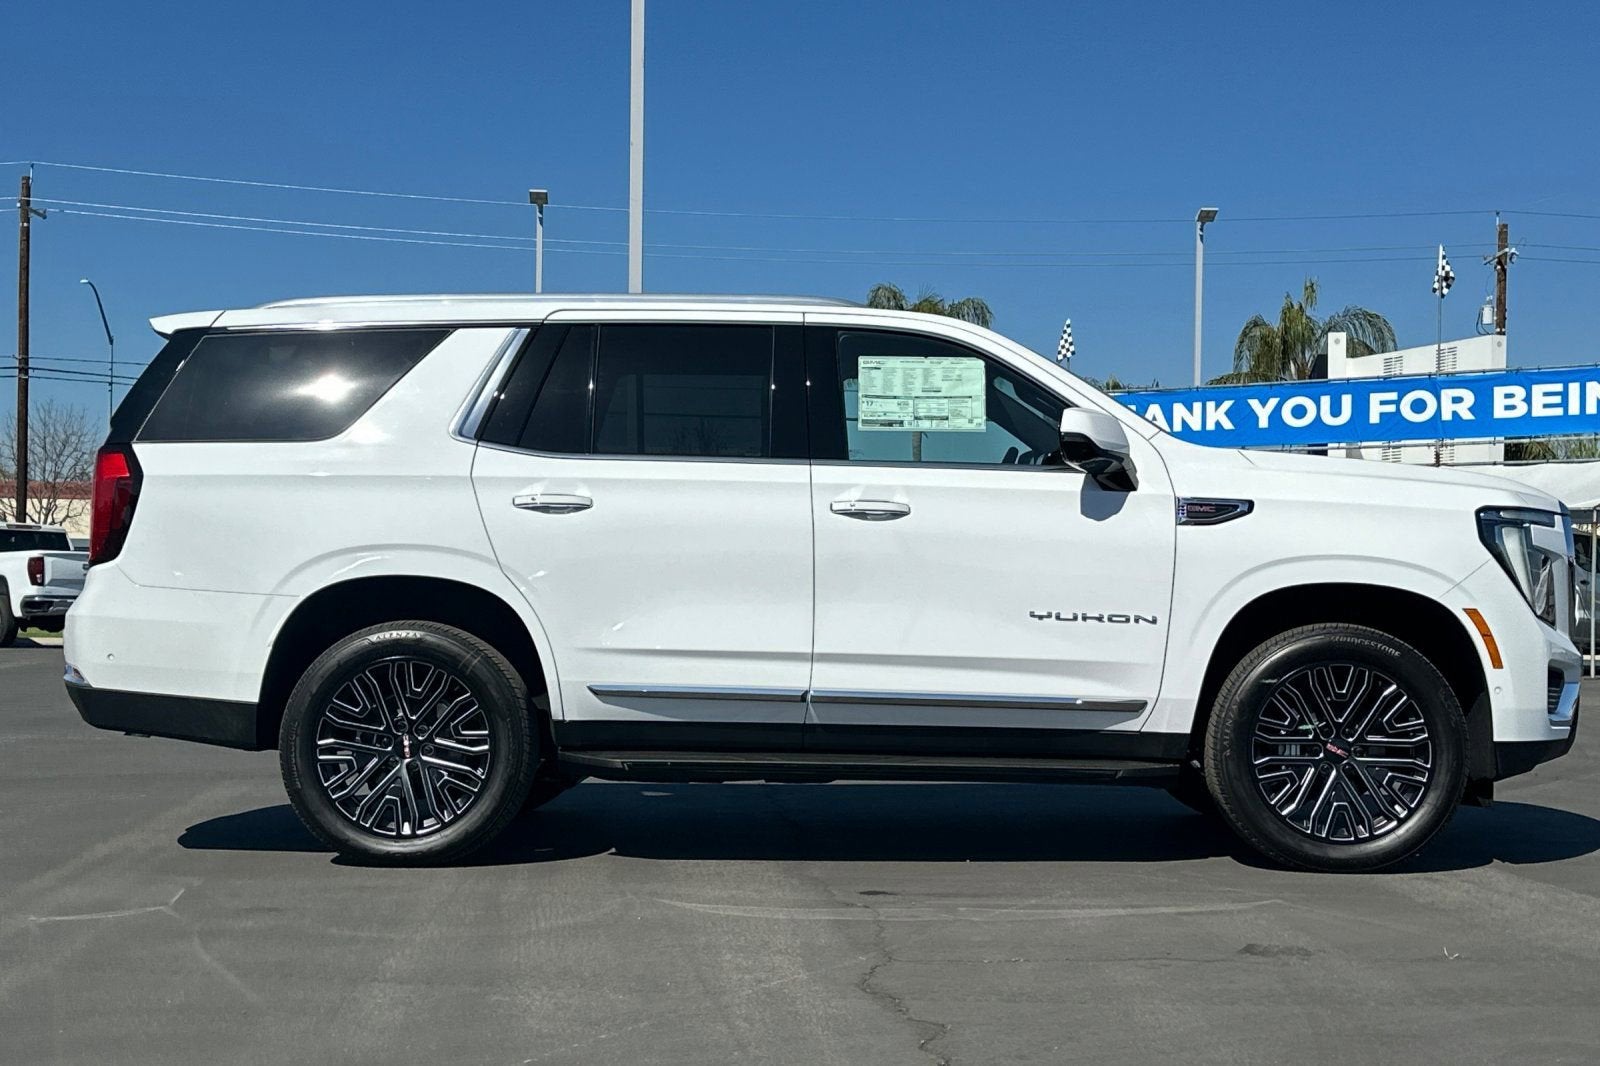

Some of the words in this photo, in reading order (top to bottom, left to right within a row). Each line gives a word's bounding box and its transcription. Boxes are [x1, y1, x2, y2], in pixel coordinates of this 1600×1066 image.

[1128, 400, 1236, 433] ANK
[1247, 394, 1352, 429] YOU
[1369, 388, 1475, 424] FOR
[1187, 504, 1217, 513] GMC
[1029, 611, 1158, 625] YUKON
